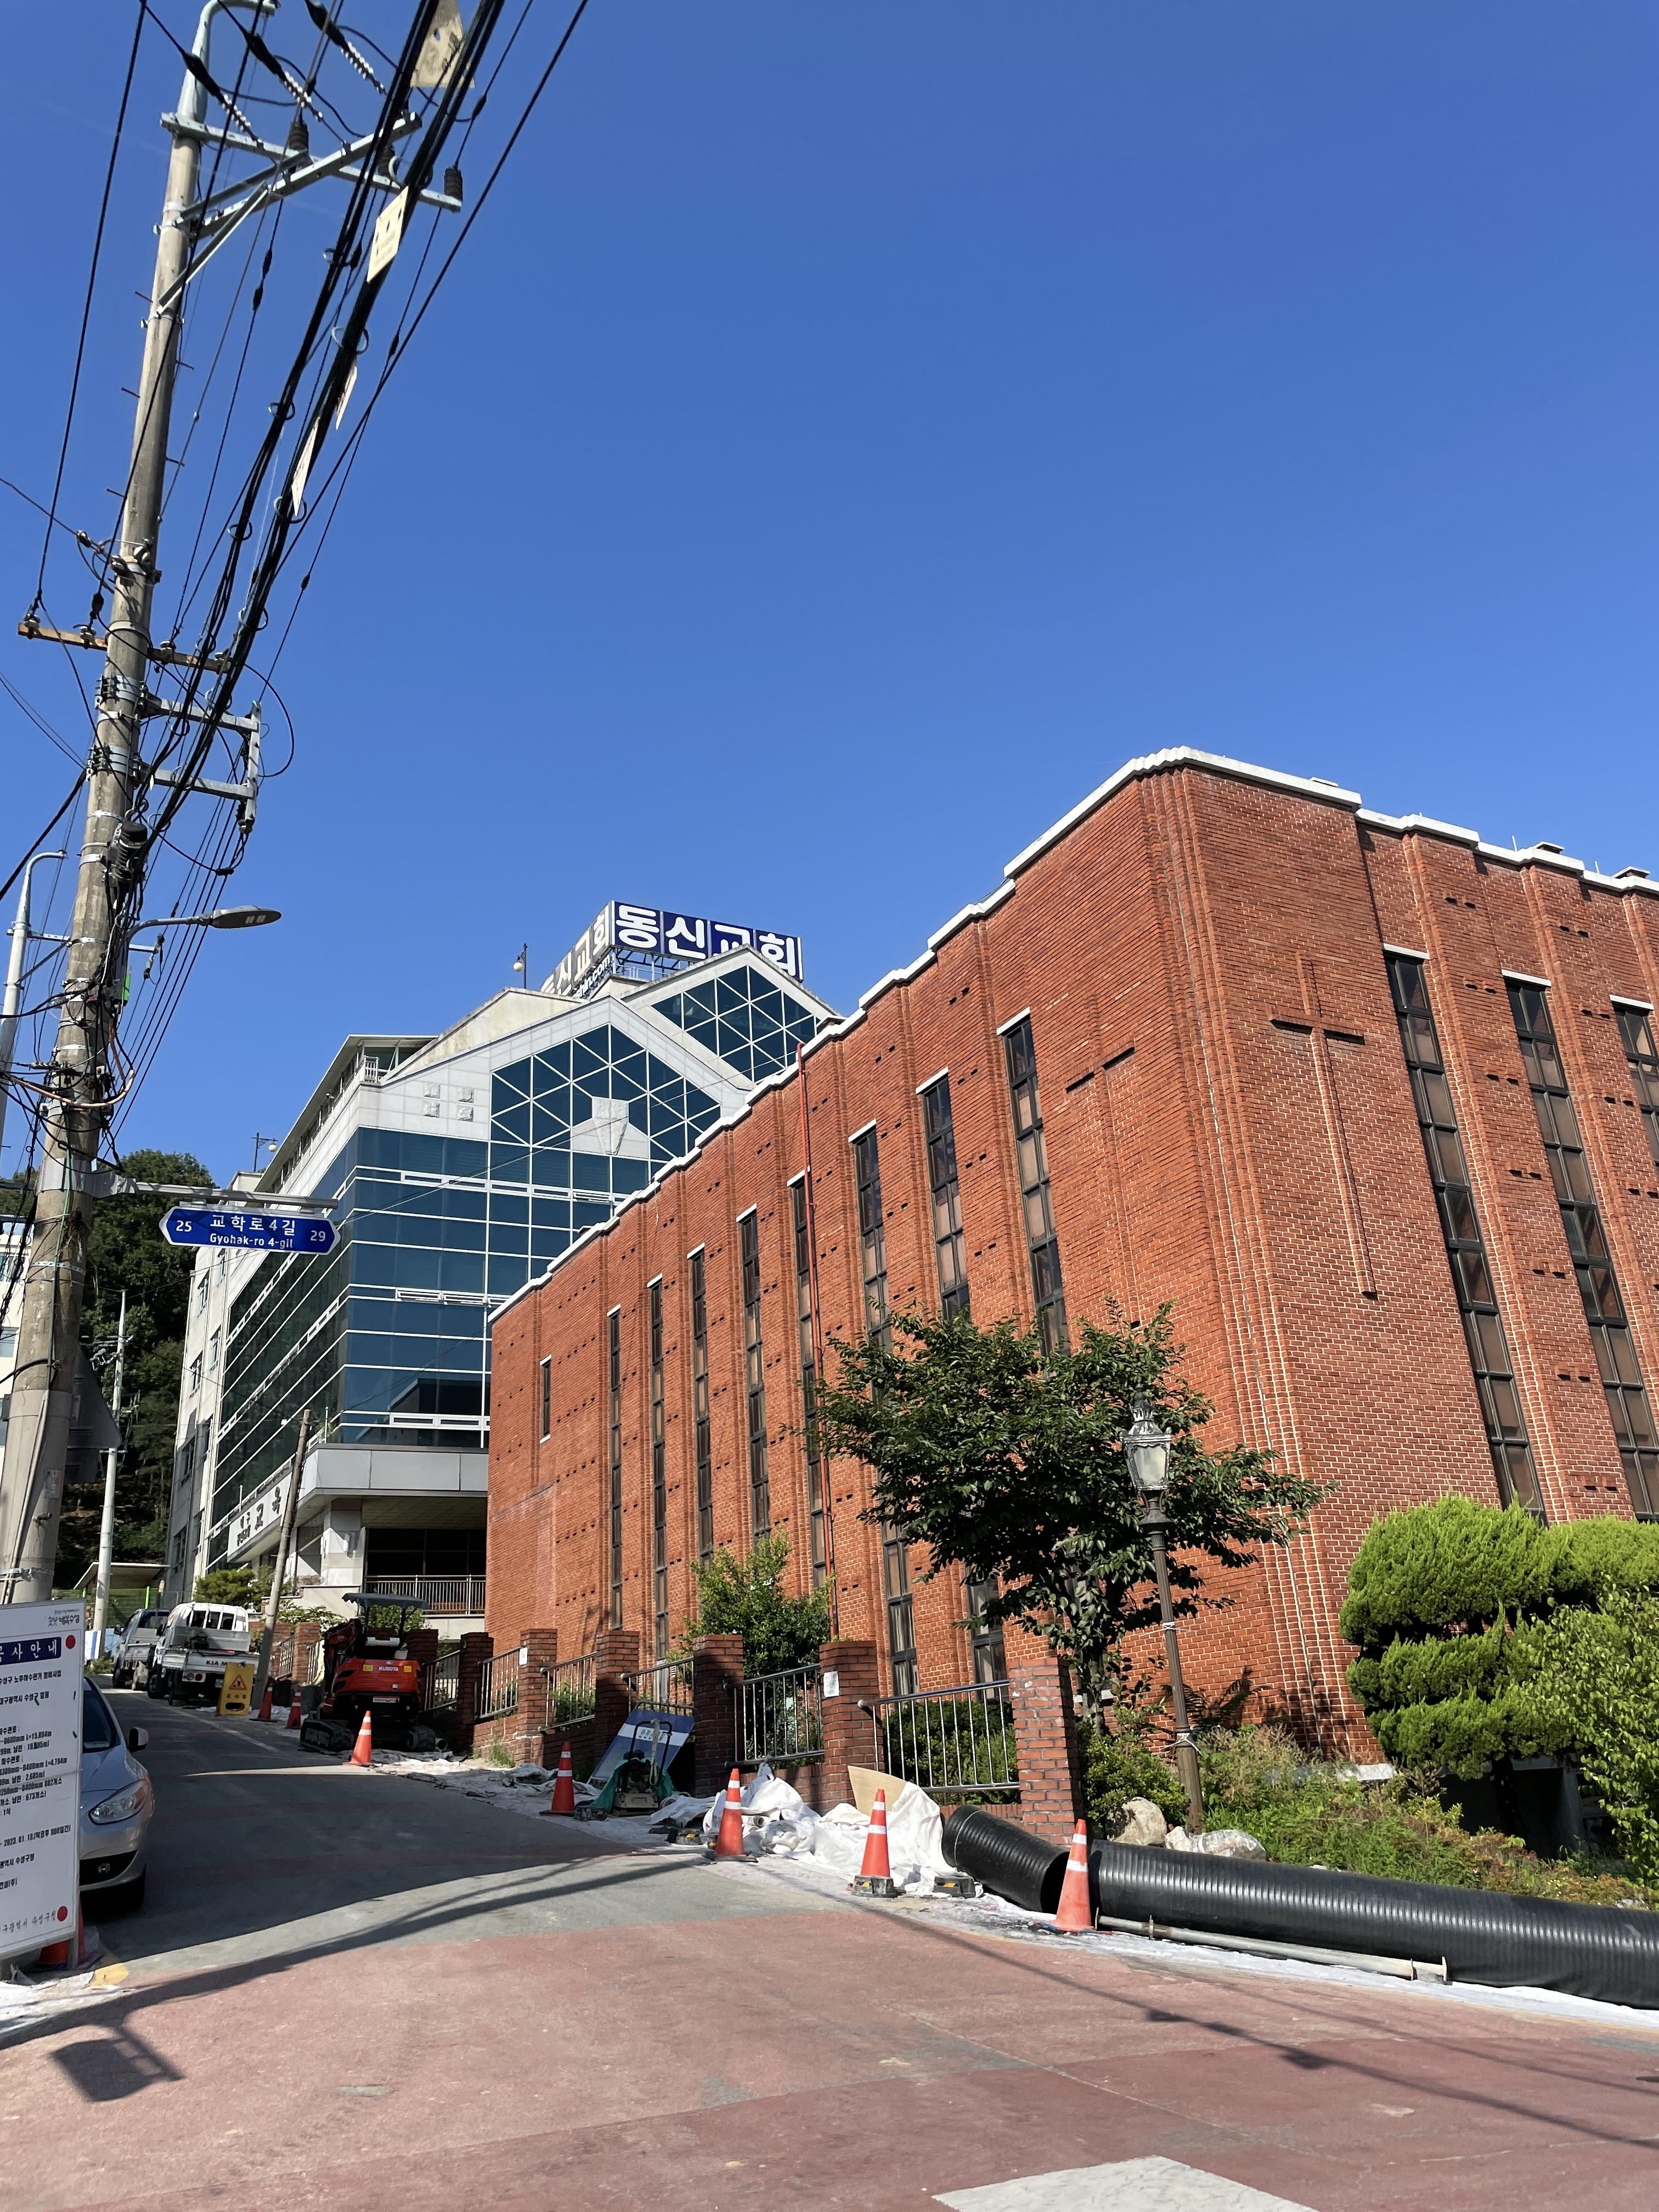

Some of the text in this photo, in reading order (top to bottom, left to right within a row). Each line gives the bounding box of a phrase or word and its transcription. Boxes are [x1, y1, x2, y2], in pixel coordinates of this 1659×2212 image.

[616, 904, 796, 977] 동신교회
[176, 1220, 192, 1232] 25
[210, 1233, 293, 1249] Gyohak-ro 4-gil
[310, 1230, 326, 1242] 29
